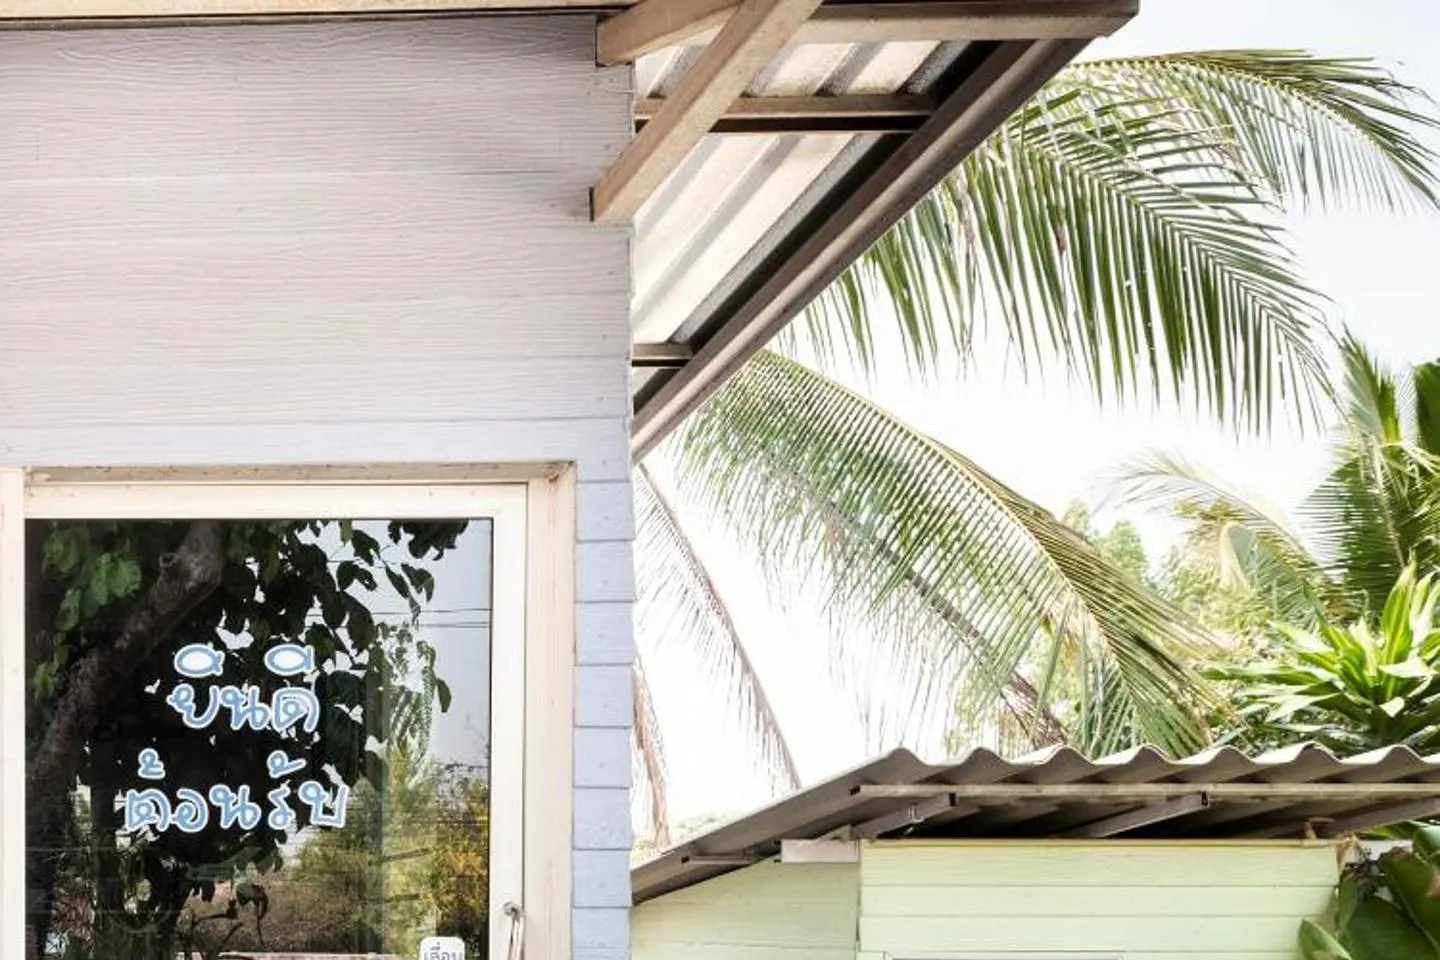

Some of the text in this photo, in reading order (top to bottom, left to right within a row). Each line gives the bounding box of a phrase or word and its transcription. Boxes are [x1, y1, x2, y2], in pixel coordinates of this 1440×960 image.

[166, 643, 320, 732] ยินดี
[125, 748, 350, 833] ต้อนรับ
